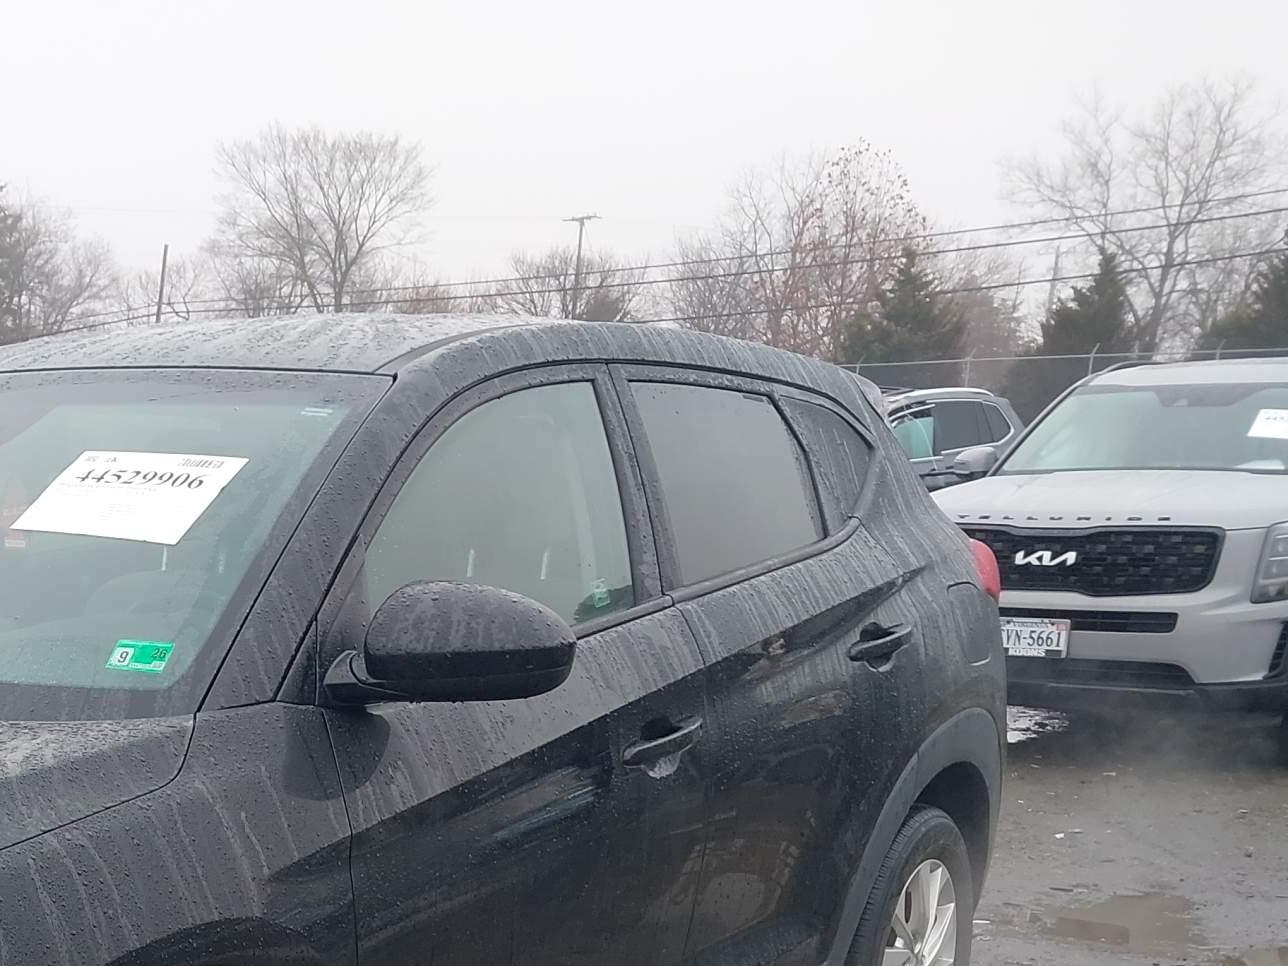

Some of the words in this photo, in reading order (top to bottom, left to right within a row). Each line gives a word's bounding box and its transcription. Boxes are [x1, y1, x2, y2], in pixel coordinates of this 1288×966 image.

[75, 468, 209, 489] 44529906
[1015, 550, 1077, 566] KIA
[118, 651, 129, 663] 9
